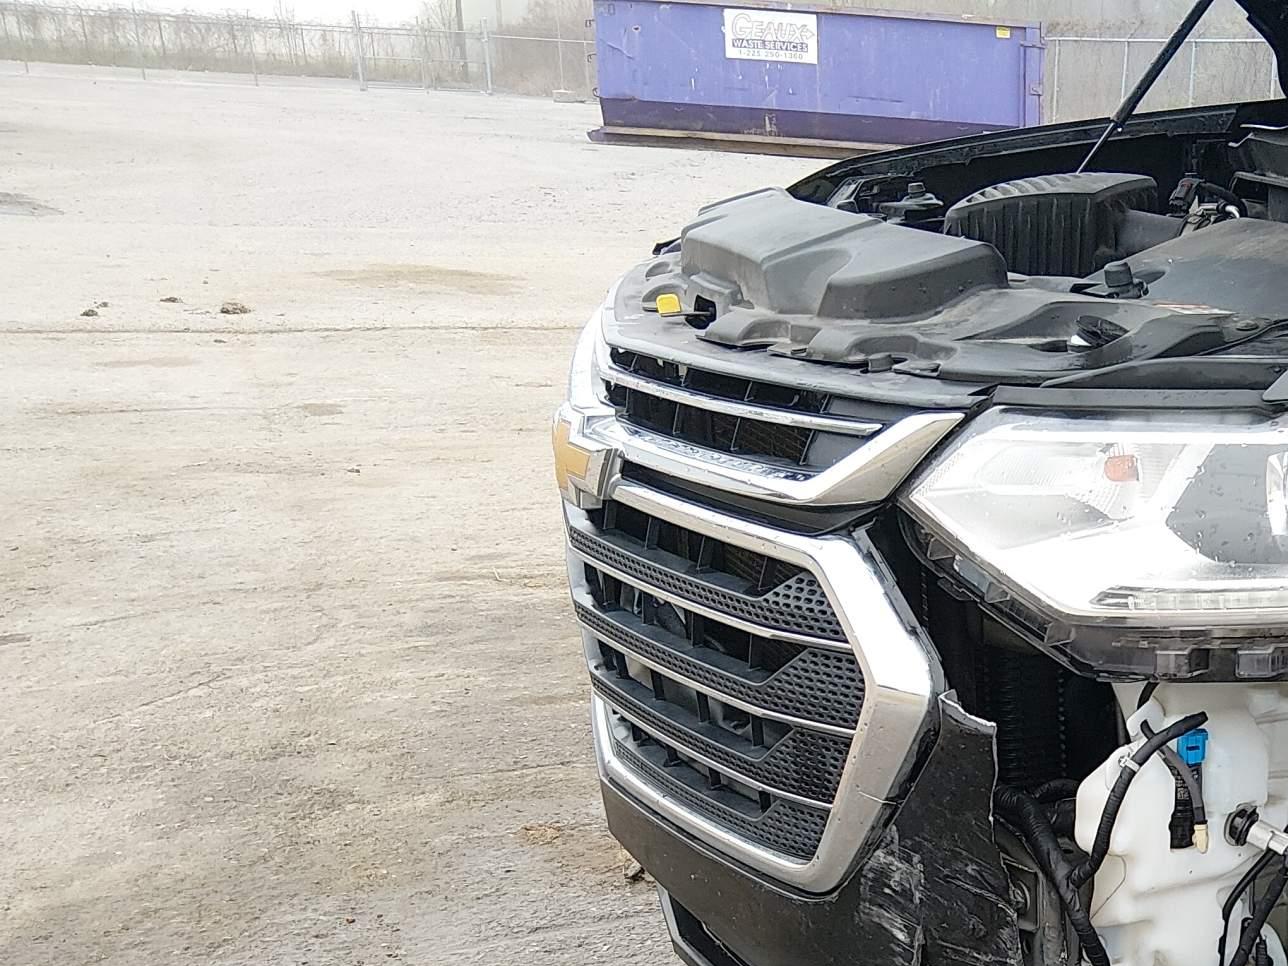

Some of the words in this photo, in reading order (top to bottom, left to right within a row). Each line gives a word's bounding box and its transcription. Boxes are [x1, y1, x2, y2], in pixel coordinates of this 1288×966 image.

[732, 13, 807, 41] GEAUX
[733, 39, 763, 49] WASTE
[765, 41, 808, 52] SERVICES
